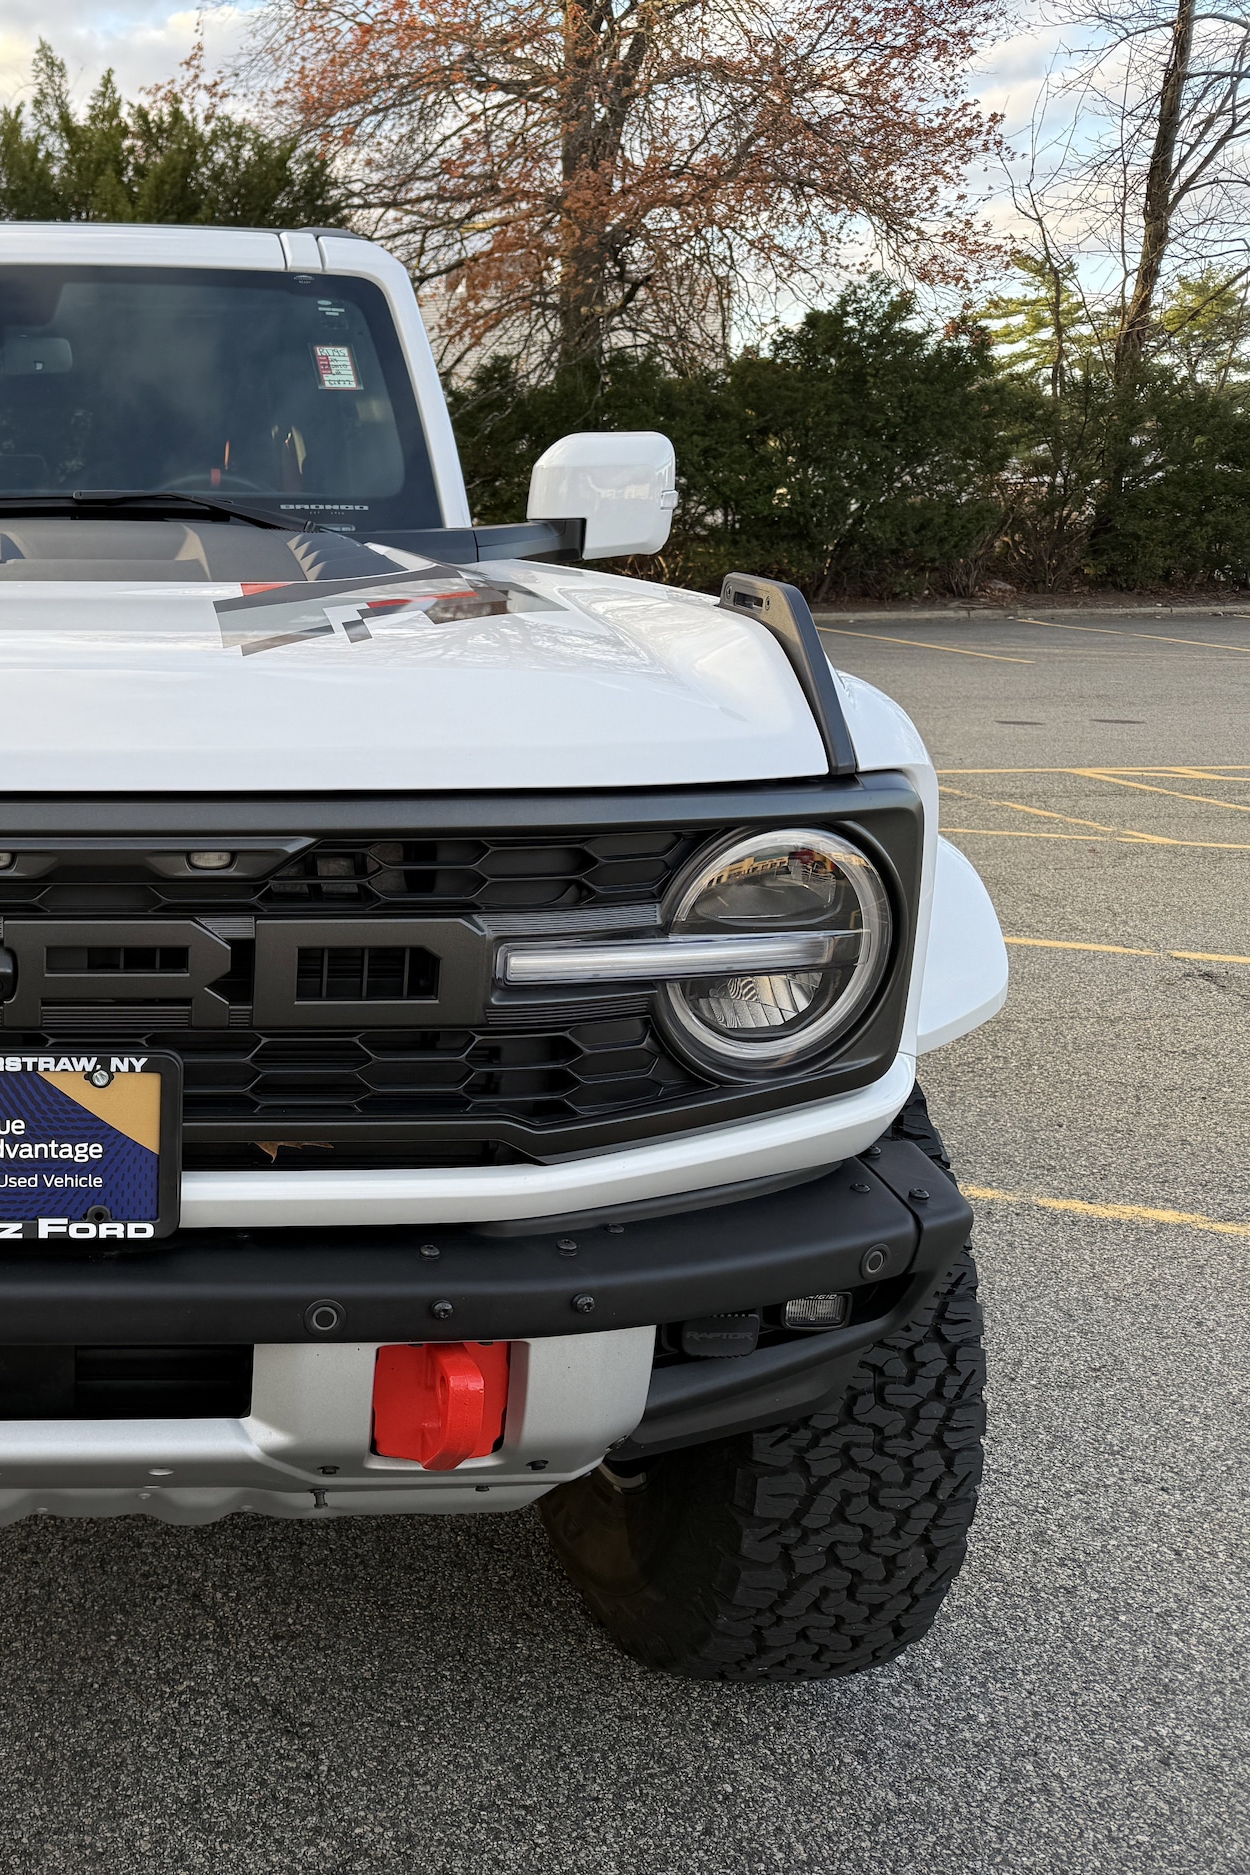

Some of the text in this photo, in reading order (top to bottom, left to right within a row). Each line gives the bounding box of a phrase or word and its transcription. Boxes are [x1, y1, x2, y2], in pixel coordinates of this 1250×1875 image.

[110, 1057, 148, 1073] NY
[41, 1173, 104, 1188] Vehicle
[685, 1331, 754, 1342] RAPTOR
